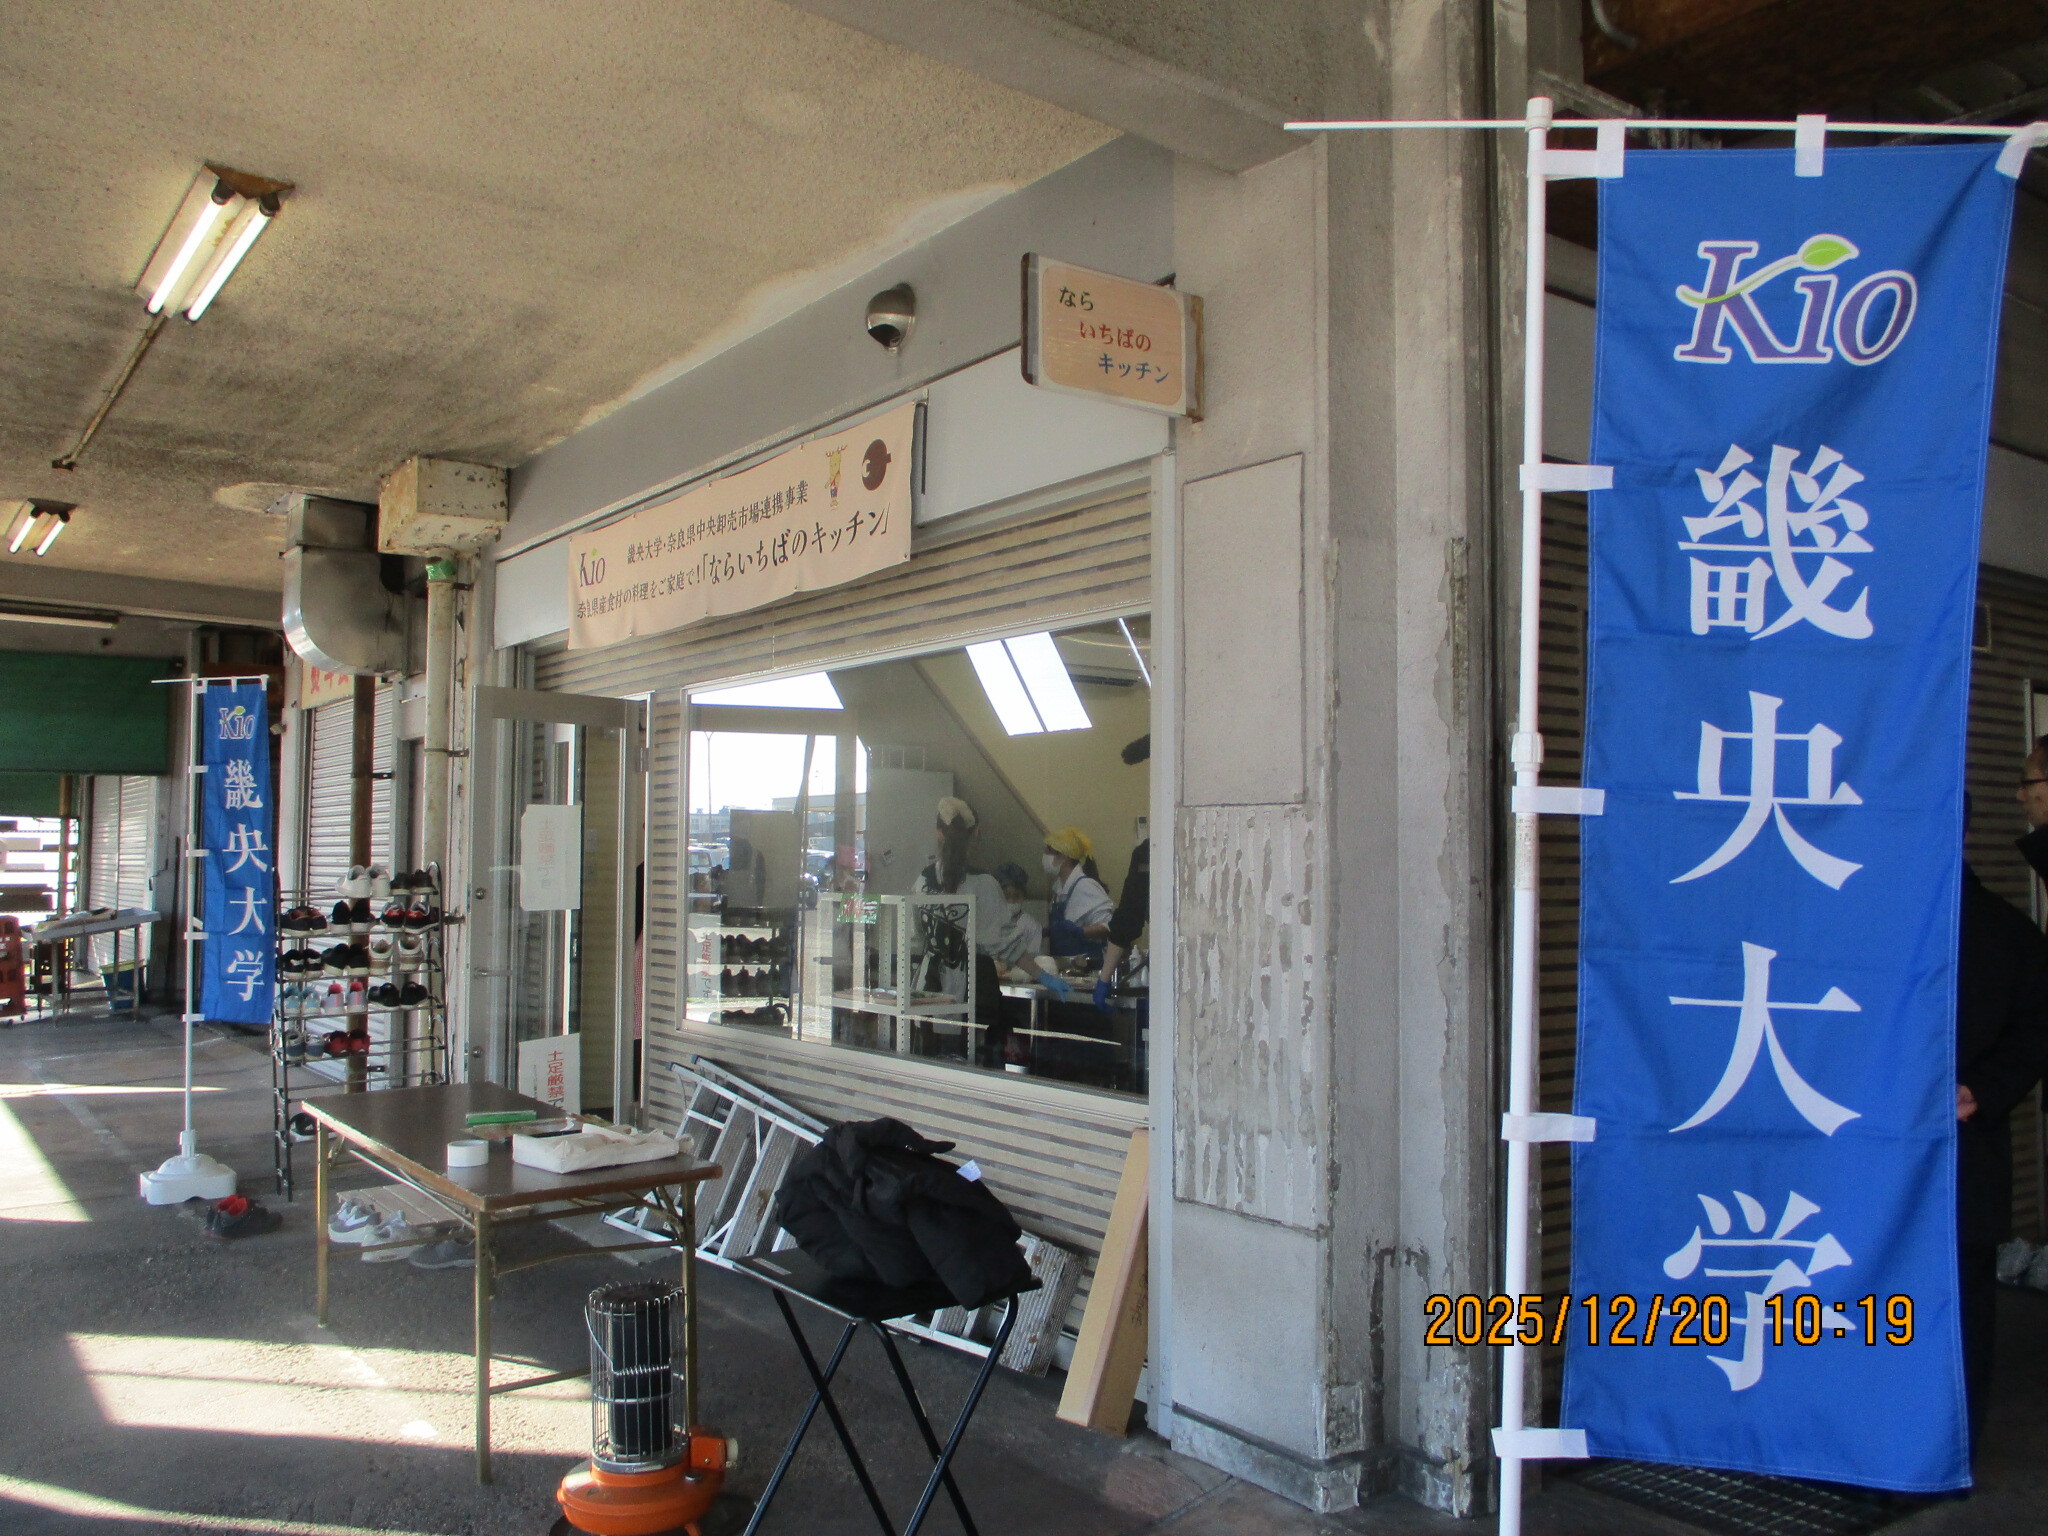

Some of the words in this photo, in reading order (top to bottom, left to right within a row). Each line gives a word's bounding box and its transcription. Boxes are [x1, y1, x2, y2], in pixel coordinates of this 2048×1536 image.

[1059, 286, 1094, 311] なら
[1674, 233, 1918, 366] Kio
[1079, 321, 1152, 352] いちばの
[1098, 353, 1170, 383] キッチン
[579, 547, 606, 588] Kio
[219, 705, 256, 740] Kio
[222, 758, 269, 1002] 畿央大学
[1663, 444, 1874, 1392] 畿央大学
